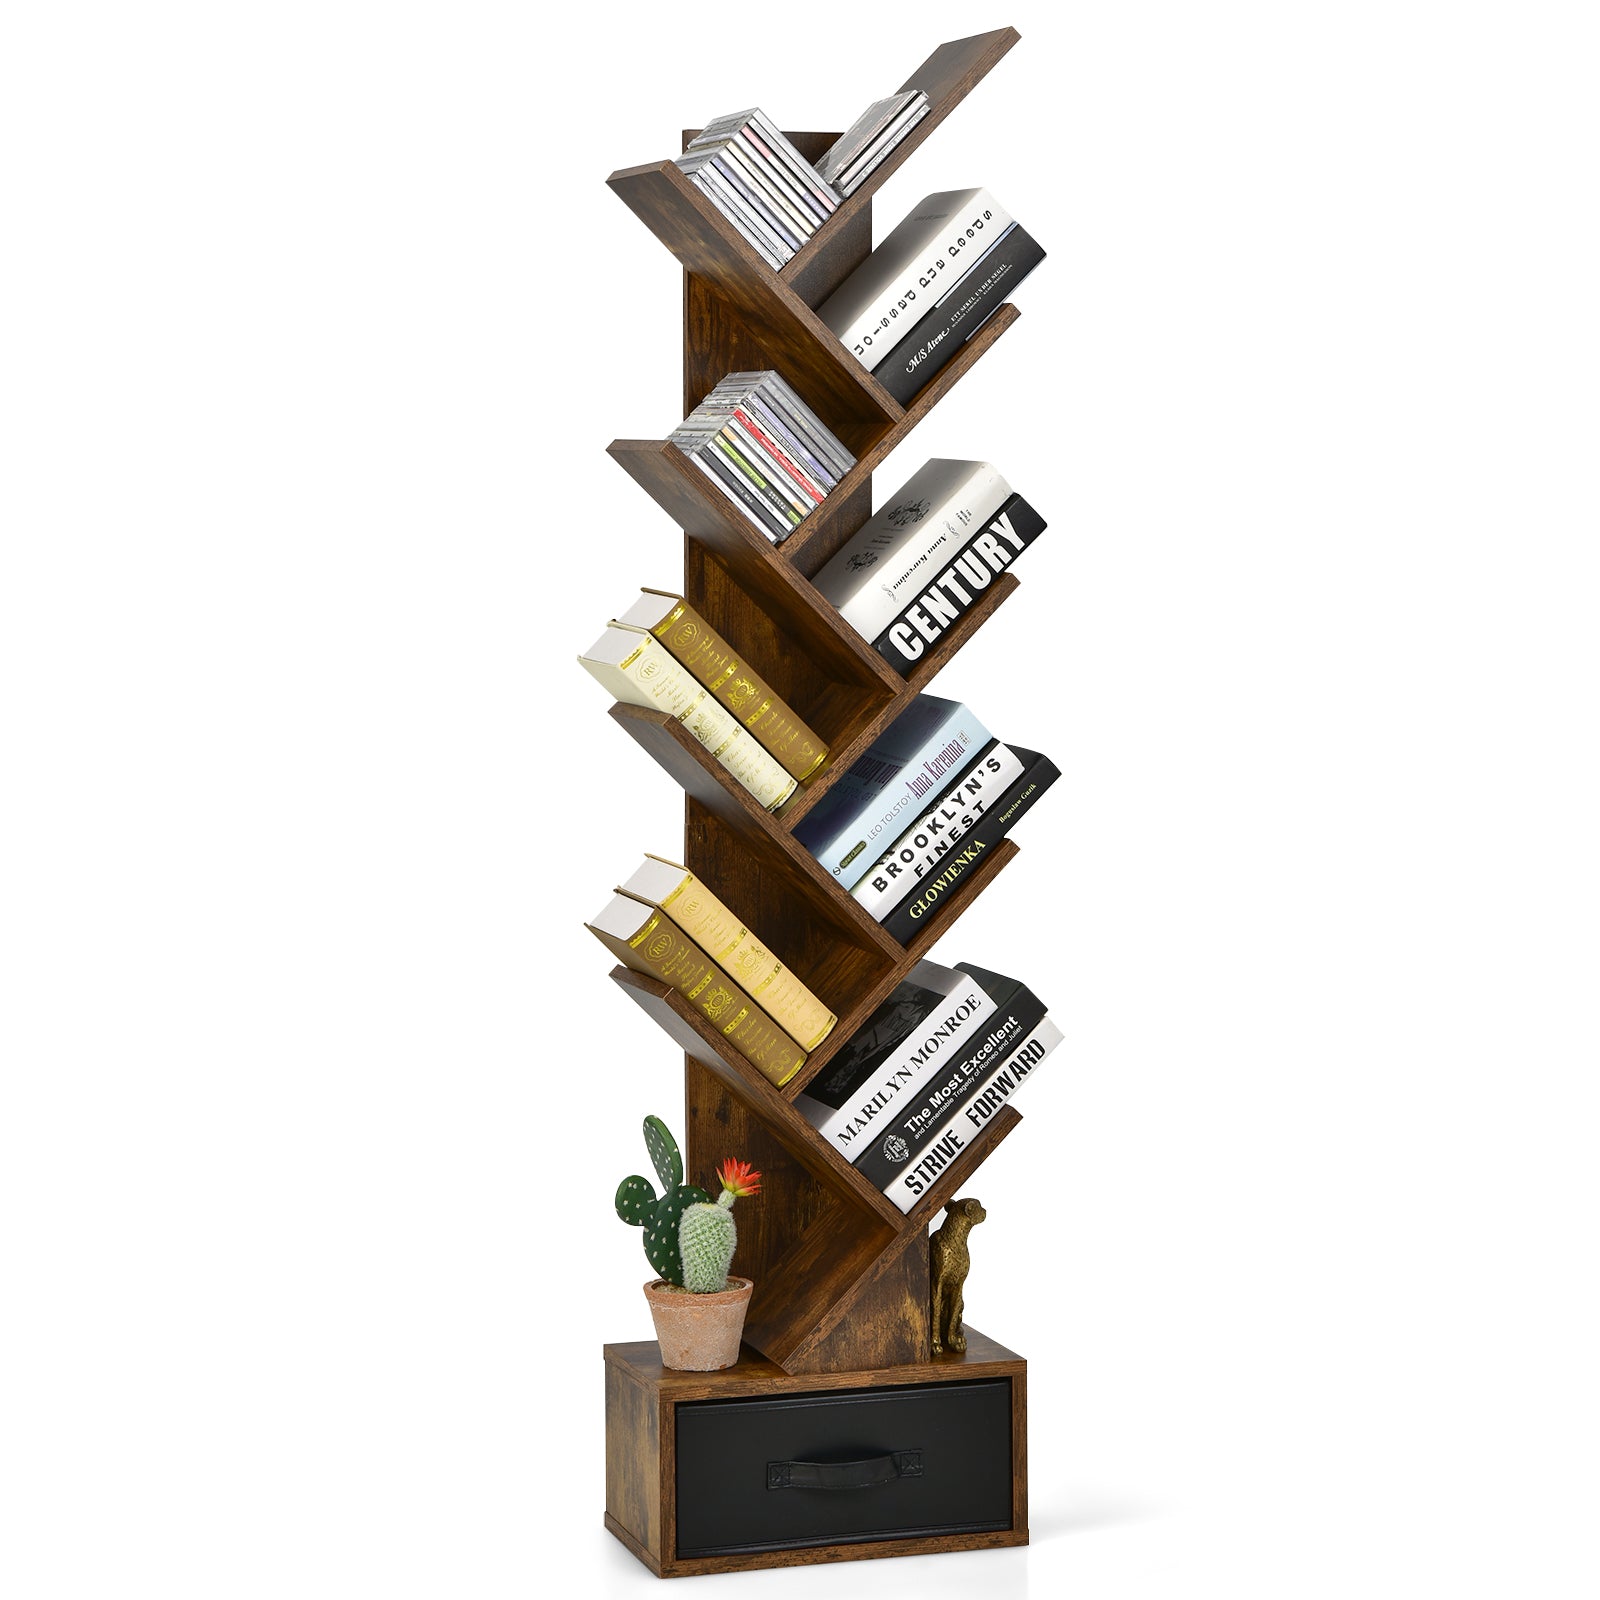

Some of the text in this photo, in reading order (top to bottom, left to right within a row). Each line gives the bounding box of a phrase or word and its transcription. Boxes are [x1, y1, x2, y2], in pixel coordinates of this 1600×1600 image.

[949, 211, 992, 257] speed
[920, 260, 945, 288] and
[854, 290, 916, 355] passion
[889, 512, 1025, 660] CENTURY
[894, 534, 946, 589] Anna Karenina
[906, 740, 966, 800] Anna Karenina
[868, 793, 912, 840] LEO TOLSTOY
[914, 800, 984, 882] FINEST
[910, 841, 986, 918] GŁOWIENKA
[654, 941, 669, 956] RW
[838, 994, 981, 1146] MARILYN MONROE
[904, 1016, 1018, 1132] The Most Excellent
[915, 1128, 925, 1139] and
[924, 1098, 954, 1128] Lamentable
[953, 1076, 975, 1097] Tragedy
[979, 1051, 998, 1070] Romeo
[998, 1040, 1009, 1052] and
[1009, 1026, 1022, 1041] Juliet
[905, 1040, 1045, 1195] STRIVE FORWARD
